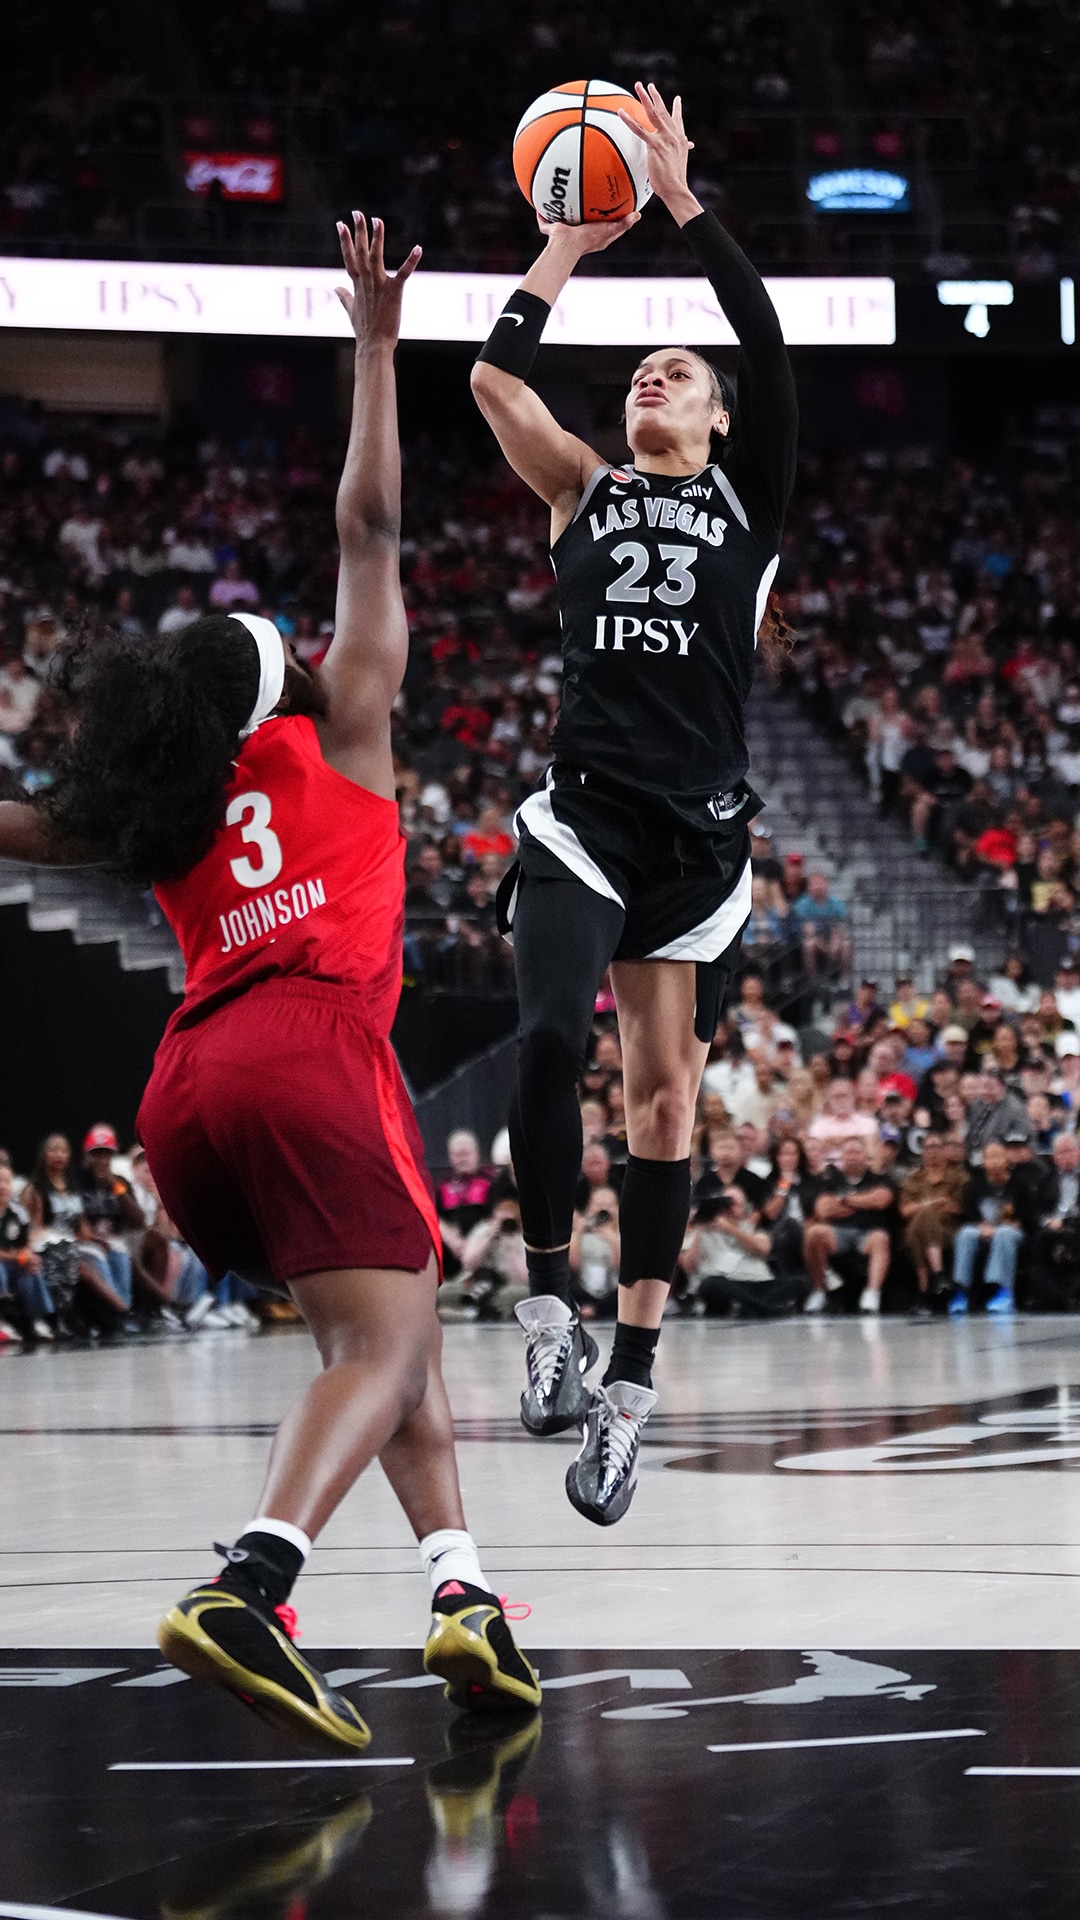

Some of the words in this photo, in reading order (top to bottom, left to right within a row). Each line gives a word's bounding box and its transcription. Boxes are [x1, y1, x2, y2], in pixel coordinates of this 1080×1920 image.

[681, 484, 713, 500] ally
[588, 499, 640, 542] LAS
[643, 497, 728, 547] VEGAS
[605, 541, 698, 606] 23
[594, 615, 699, 656] IPSY
[226, 790, 283, 888] 3
[218, 878, 326, 953] JOHNSON
